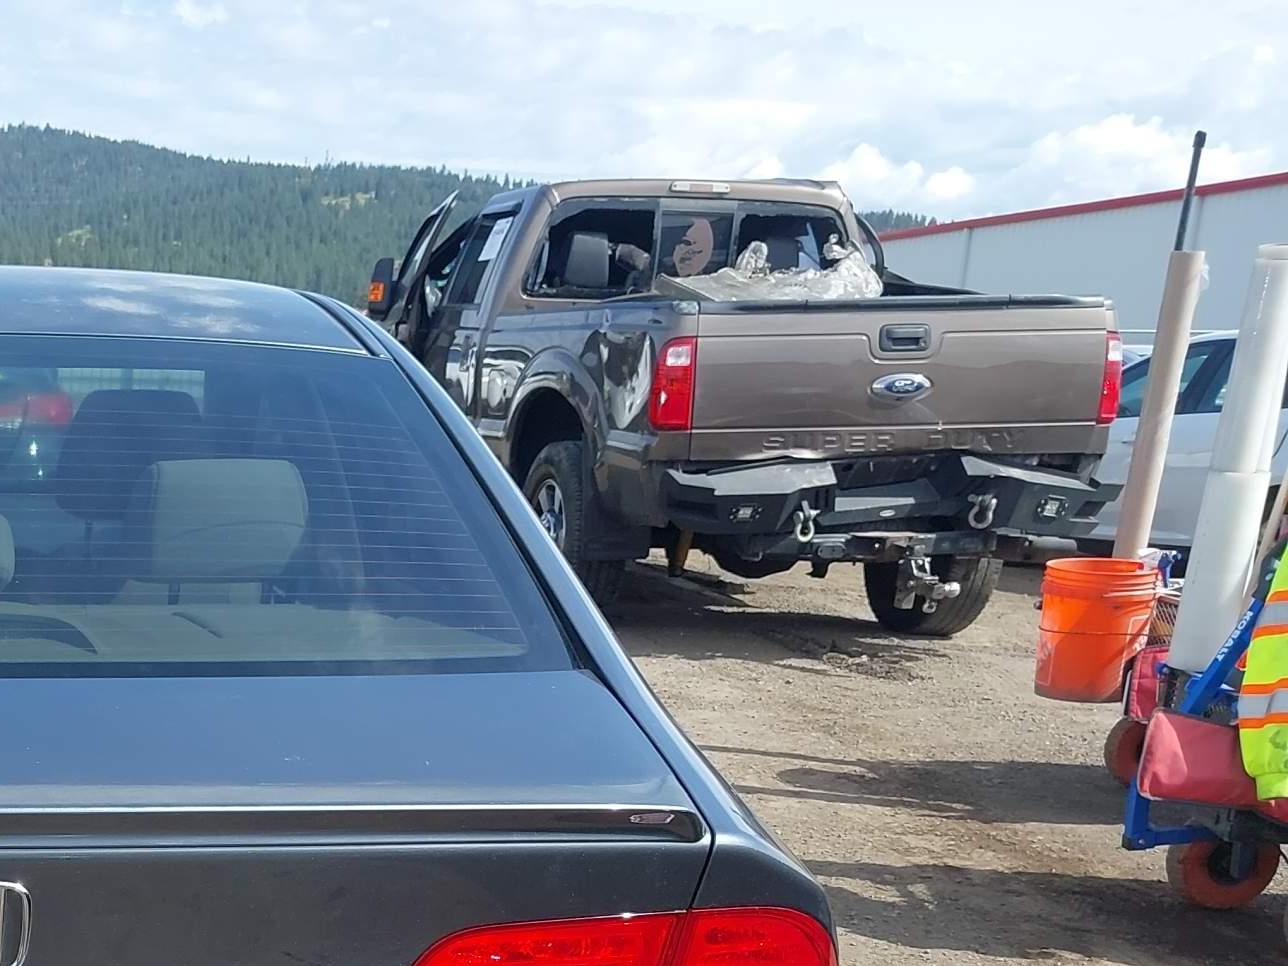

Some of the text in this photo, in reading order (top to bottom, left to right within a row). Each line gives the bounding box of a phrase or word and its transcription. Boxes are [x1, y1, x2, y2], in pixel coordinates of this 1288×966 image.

[761, 430, 1022, 452] SUPER DUTY
[1216, 610, 1254, 662] KOBALT
